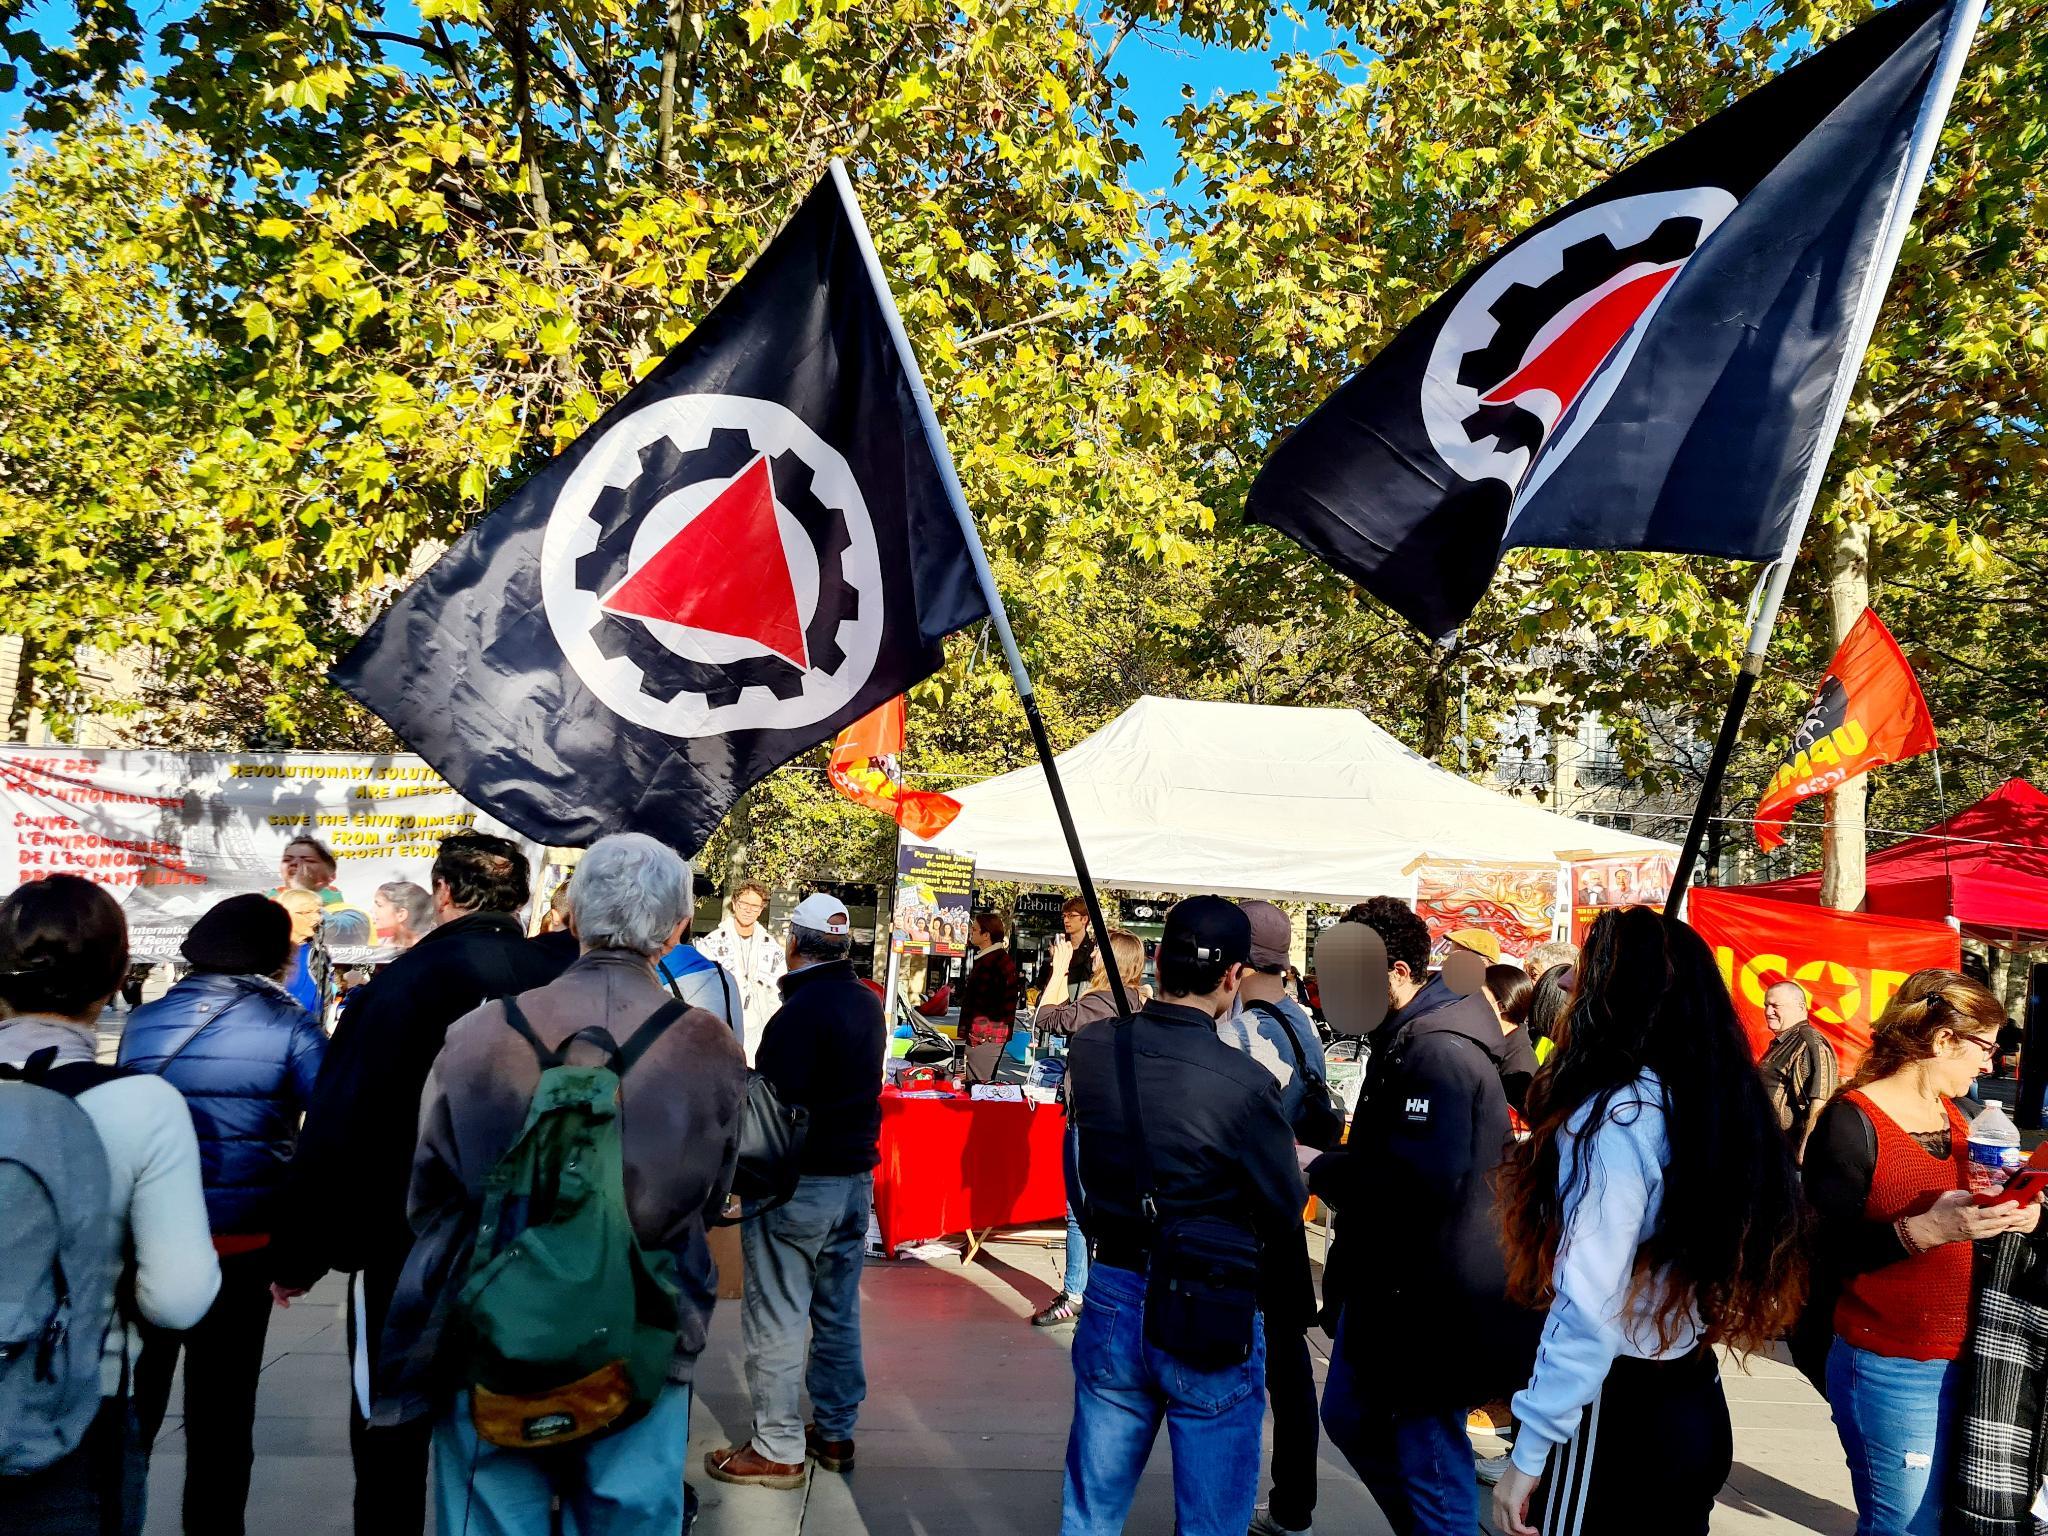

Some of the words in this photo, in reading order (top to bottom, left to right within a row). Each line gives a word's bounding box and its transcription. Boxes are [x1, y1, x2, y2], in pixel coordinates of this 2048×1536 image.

[229, 764, 373, 779] REVOLUTIONARY
[356, 784, 391, 800] ARE
[395, 786, 457, 798] NEEDE
[267, 814, 311, 827] SAVE
[315, 815, 349, 827] THE
[353, 813, 477, 830] ENVIRONMENT
[331, 831, 380, 846] FROM
[19, 849, 43, 865] DE
[333, 846, 395, 860] PROFIT
[914, 850, 934, 860] Pour
[910, 867, 972, 880] anticapitaliste
[926, 885, 970, 896] cialisme
[1018, 895, 1063, 912] habita
[130, 925, 191, 935] Internatio
[1405, 1098, 1429, 1114] HH
